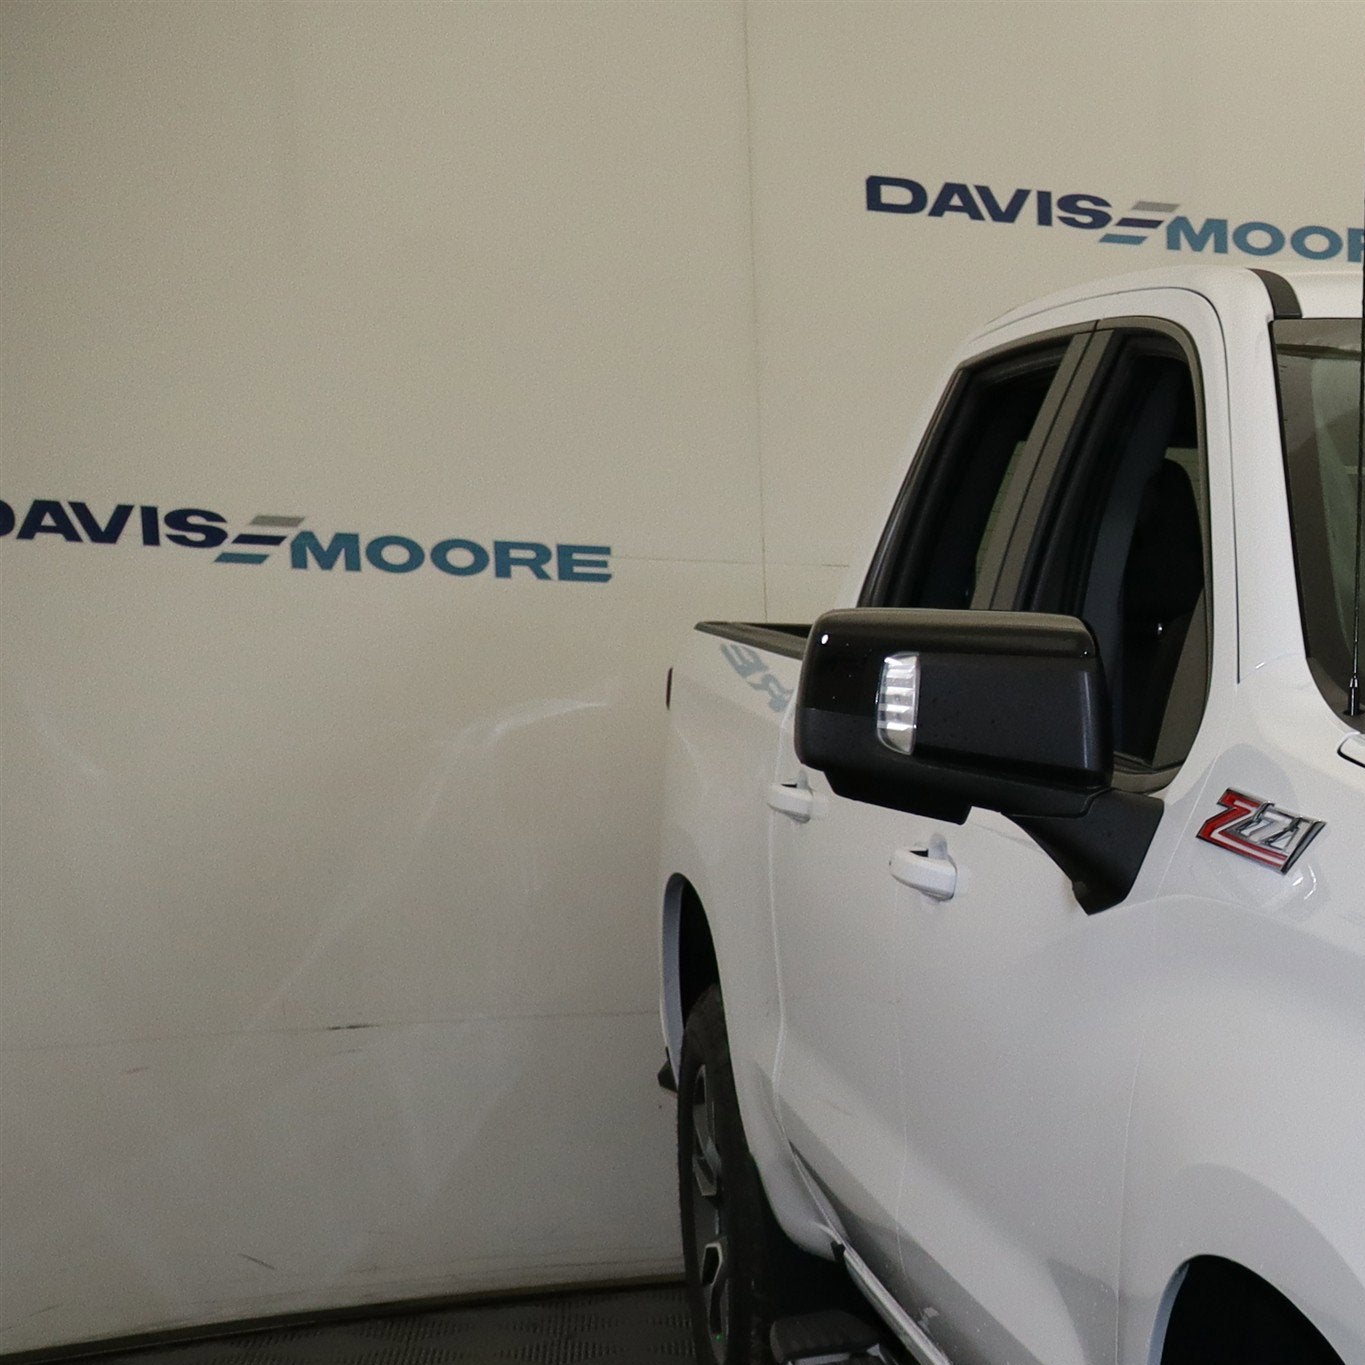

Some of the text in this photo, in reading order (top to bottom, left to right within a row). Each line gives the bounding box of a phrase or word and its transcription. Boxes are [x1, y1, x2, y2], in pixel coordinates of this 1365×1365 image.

[866, 175, 1112, 230] DAVIS
[0, 499, 612, 583] AVIS MOORE
[1196, 788, 1327, 875] Z71
